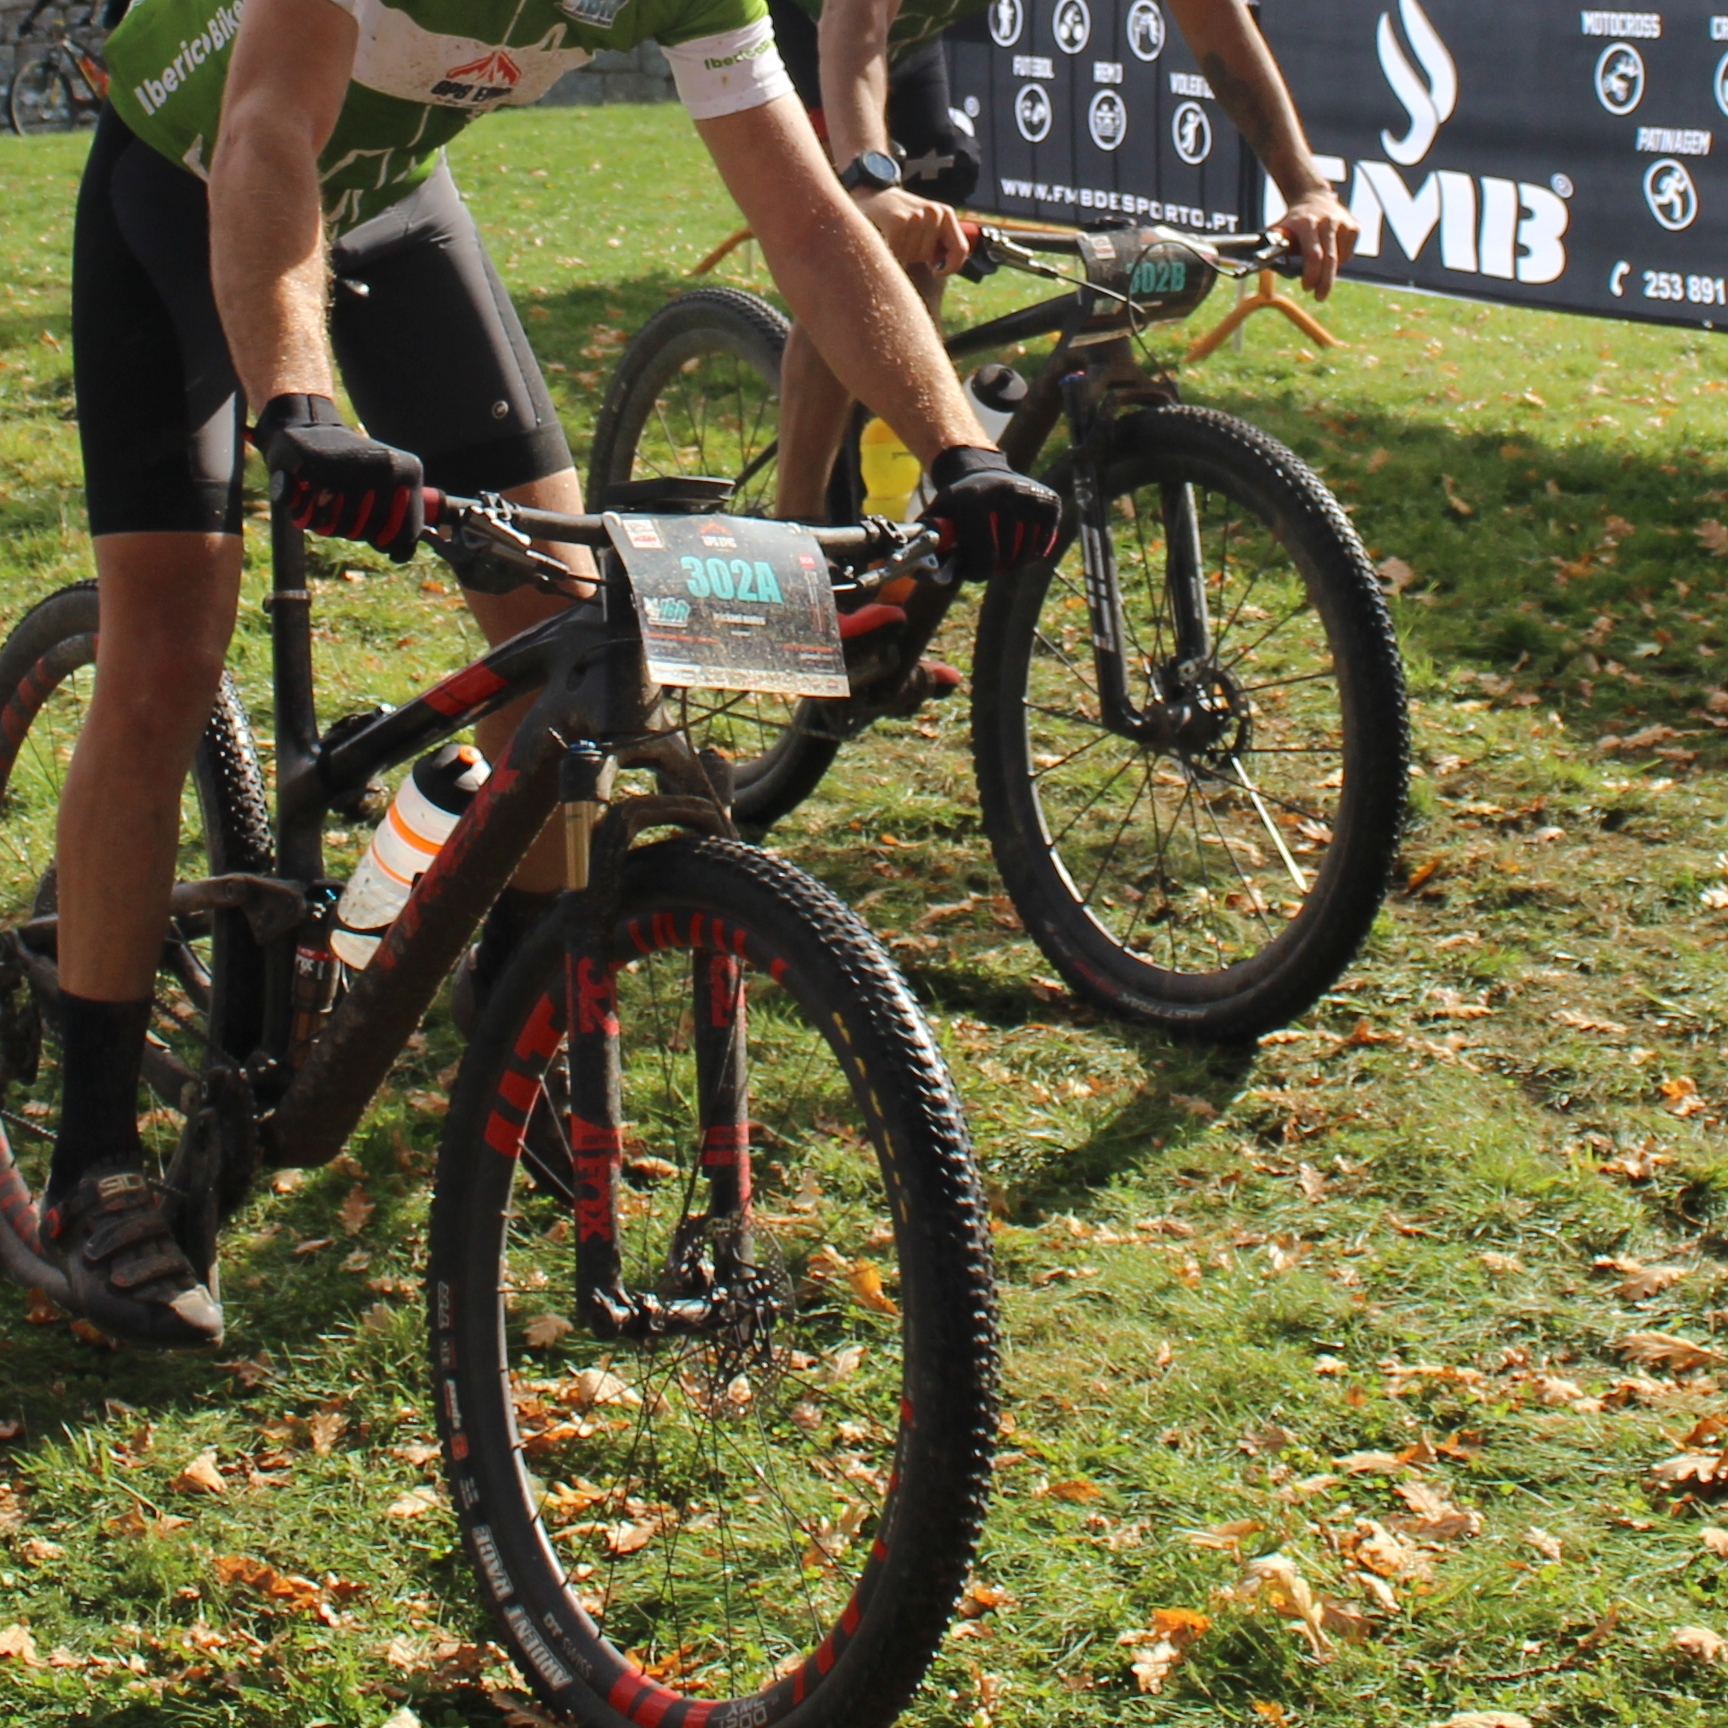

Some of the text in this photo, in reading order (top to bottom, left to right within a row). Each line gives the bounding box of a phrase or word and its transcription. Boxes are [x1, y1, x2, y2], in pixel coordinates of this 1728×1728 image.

[1581, 10, 1662, 40] MOTOCROSS
[1635, 125, 1713, 157] PATINAGEM
[1000, 177, 1240, 234] WWW.FMBDESPORTO.PT
[1641, 270, 1684, 304] 253
[1685, 275, 1727, 307] 891
[680, 555, 785, 604] 302A
[472, 1523, 574, 1691] ARDENT RACE
